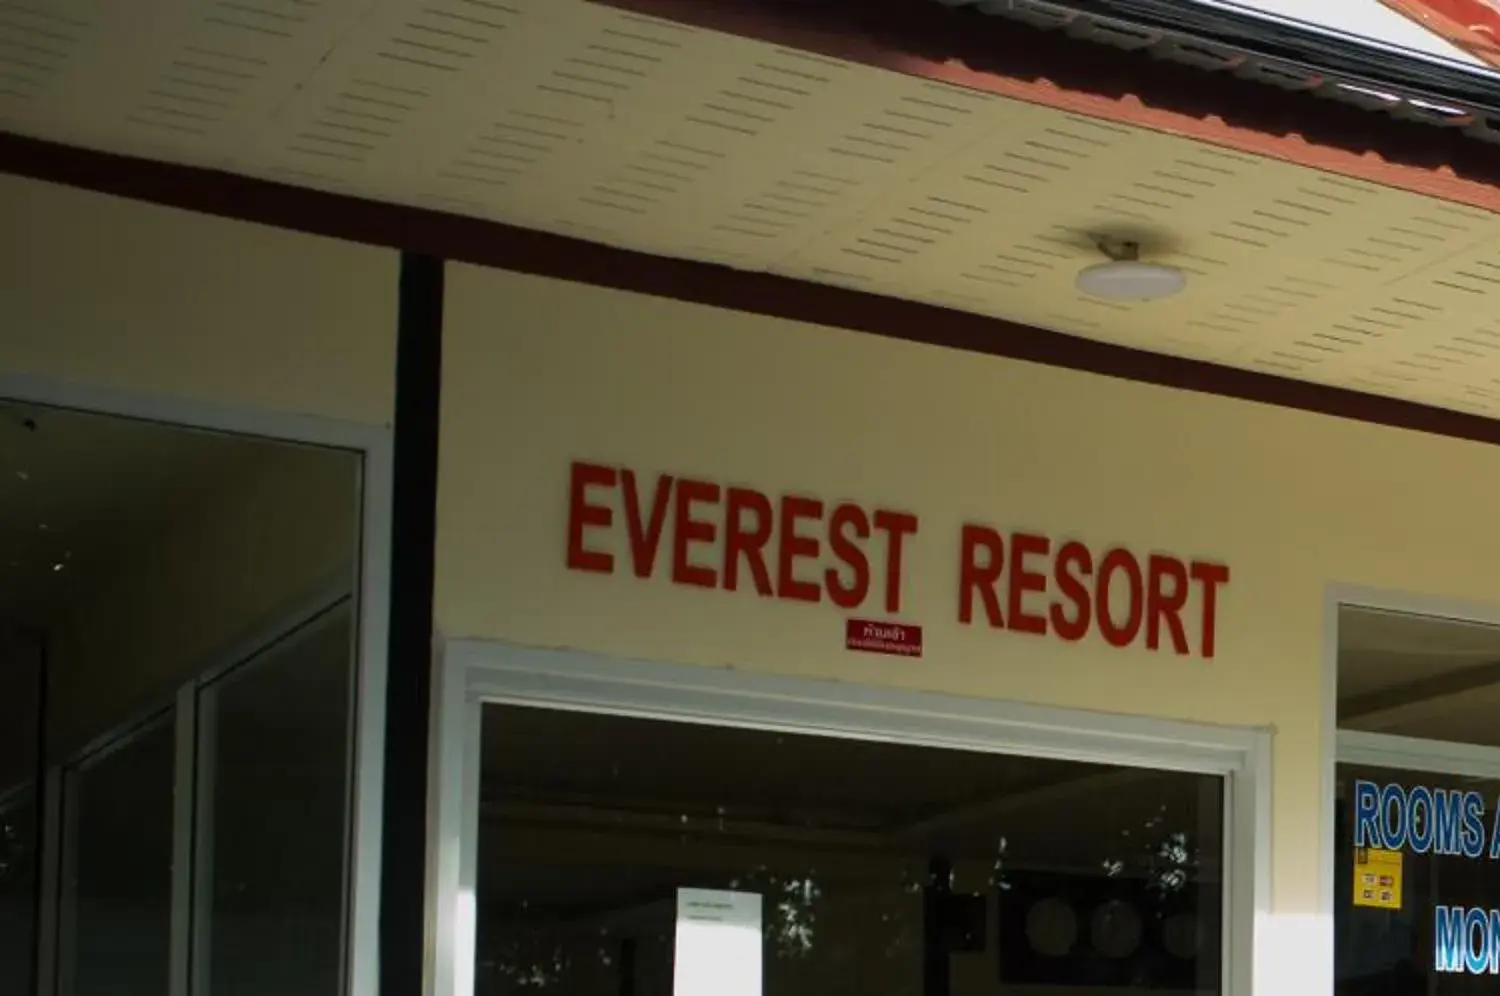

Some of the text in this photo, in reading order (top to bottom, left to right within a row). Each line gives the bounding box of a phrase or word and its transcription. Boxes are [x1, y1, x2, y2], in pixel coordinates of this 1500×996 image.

[565, 461, 1230, 658] EVEREST RESORT
[1354, 779, 1484, 858] ROOMS
